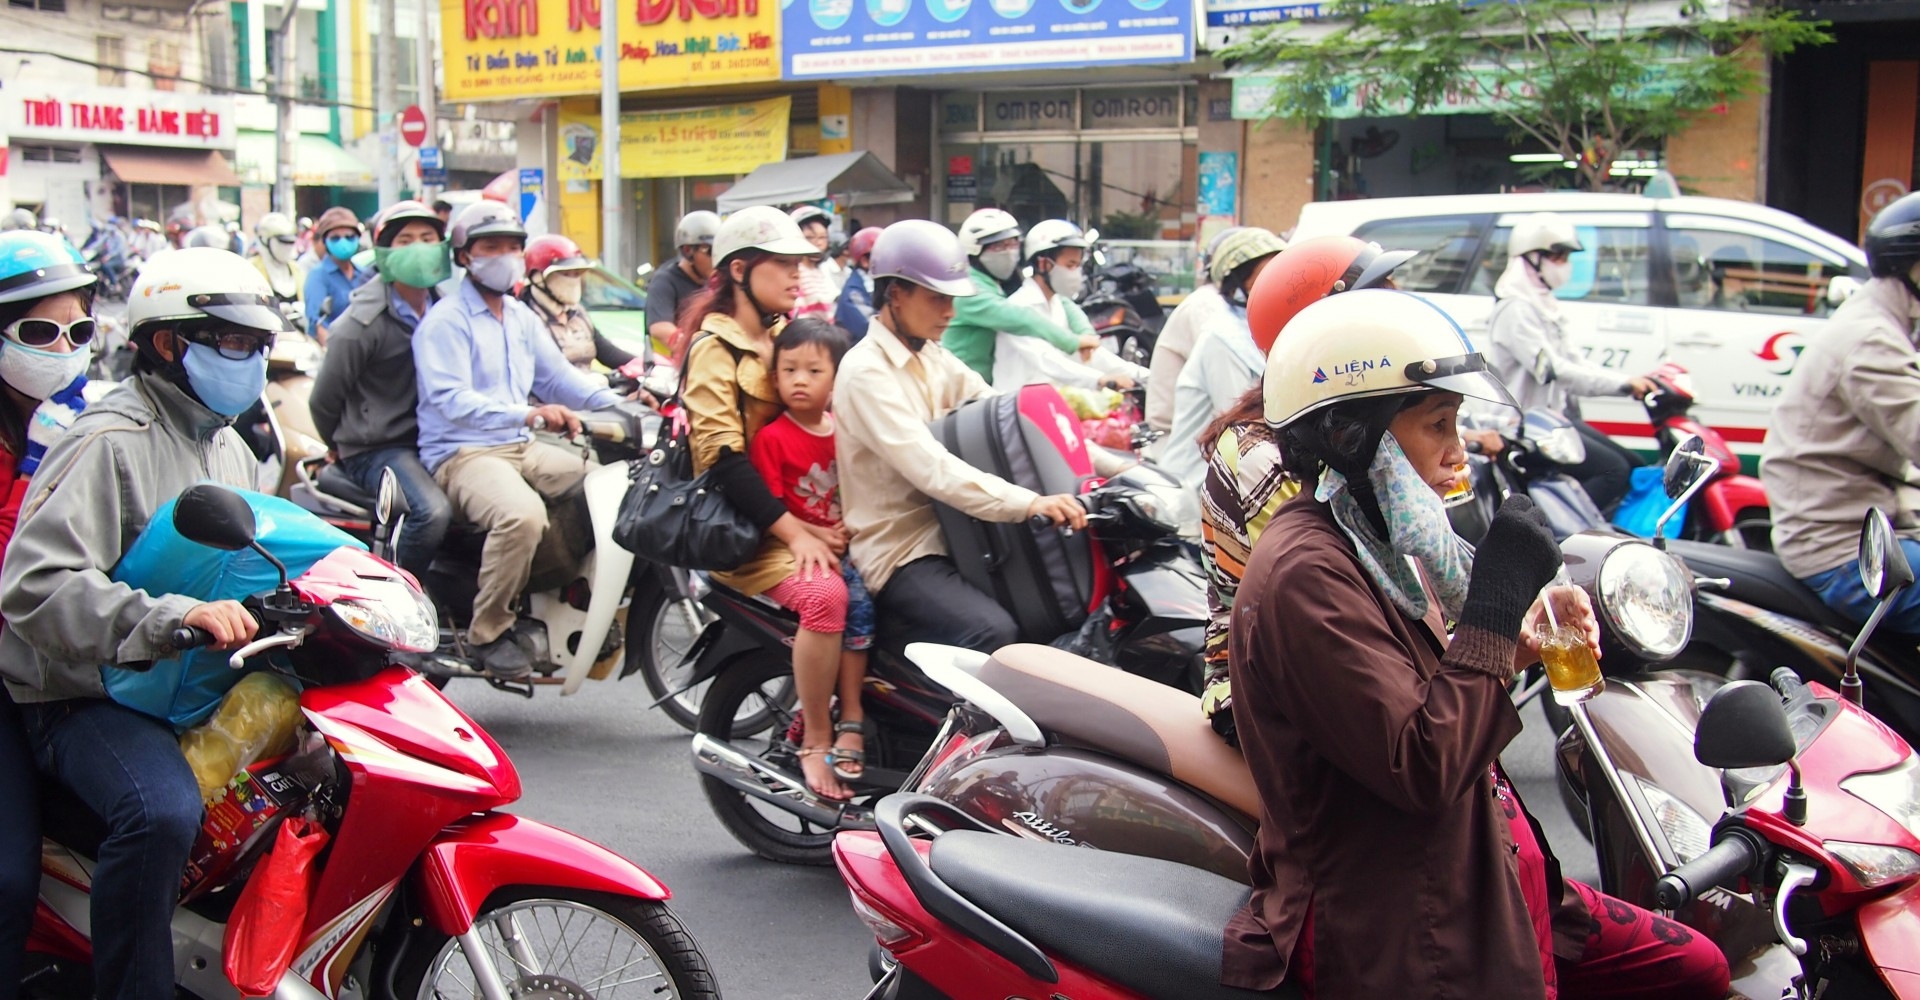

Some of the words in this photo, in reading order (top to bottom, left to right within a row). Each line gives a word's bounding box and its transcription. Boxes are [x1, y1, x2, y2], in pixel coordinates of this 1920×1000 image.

[1222, 12, 1247, 25] 107
[24, 94, 62, 127] THỜI
[70, 102, 124, 132] TRANG
[138, 103, 180, 135] HÀNG
[185, 106, 220, 142] HIỆU
[995, 100, 1072, 121] OMRON
[1092, 98, 1176, 119] OMRON
[681, 125, 718, 144] triệu
[1334, 359, 1374, 376] LIÊN
[1379, 355, 1392, 368] Á
